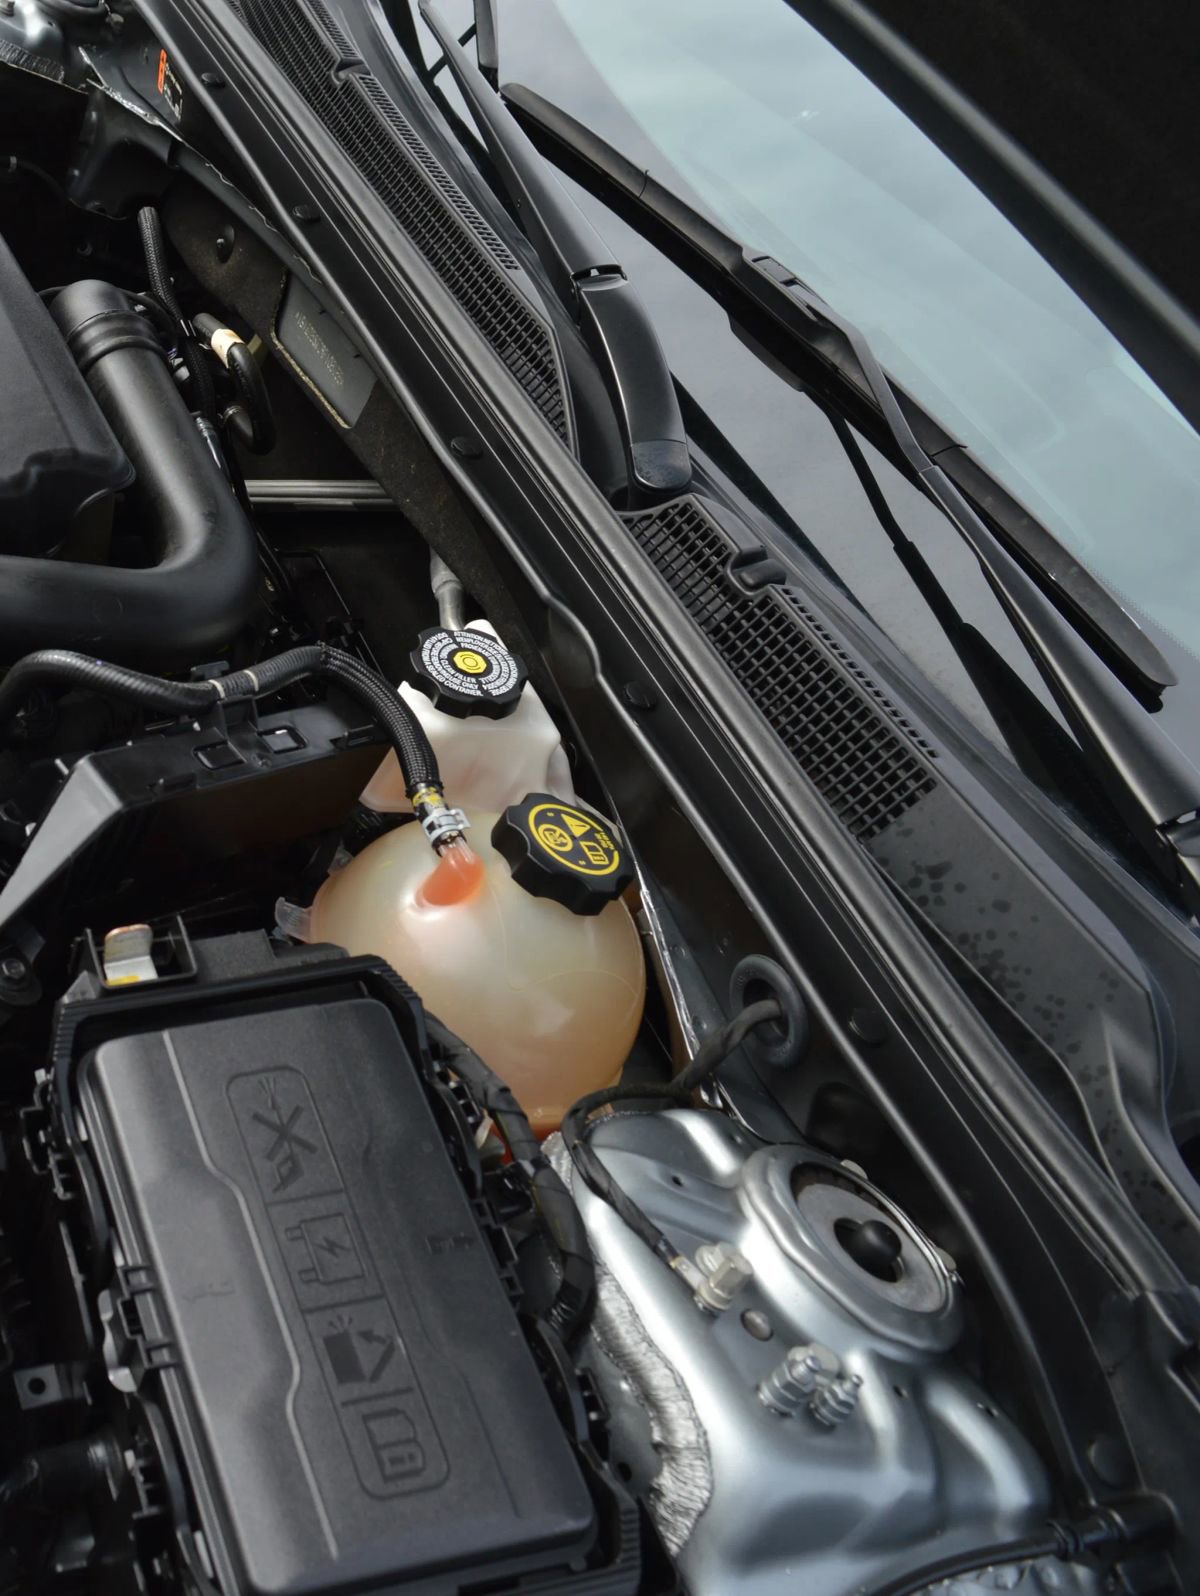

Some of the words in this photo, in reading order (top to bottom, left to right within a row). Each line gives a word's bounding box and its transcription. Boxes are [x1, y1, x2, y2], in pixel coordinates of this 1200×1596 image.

[426, 664, 445, 684] SEALED
[440, 660, 456, 675] CLEAN
[454, 672, 478, 684] FILLER
[462, 681, 479, 690] ONLY
